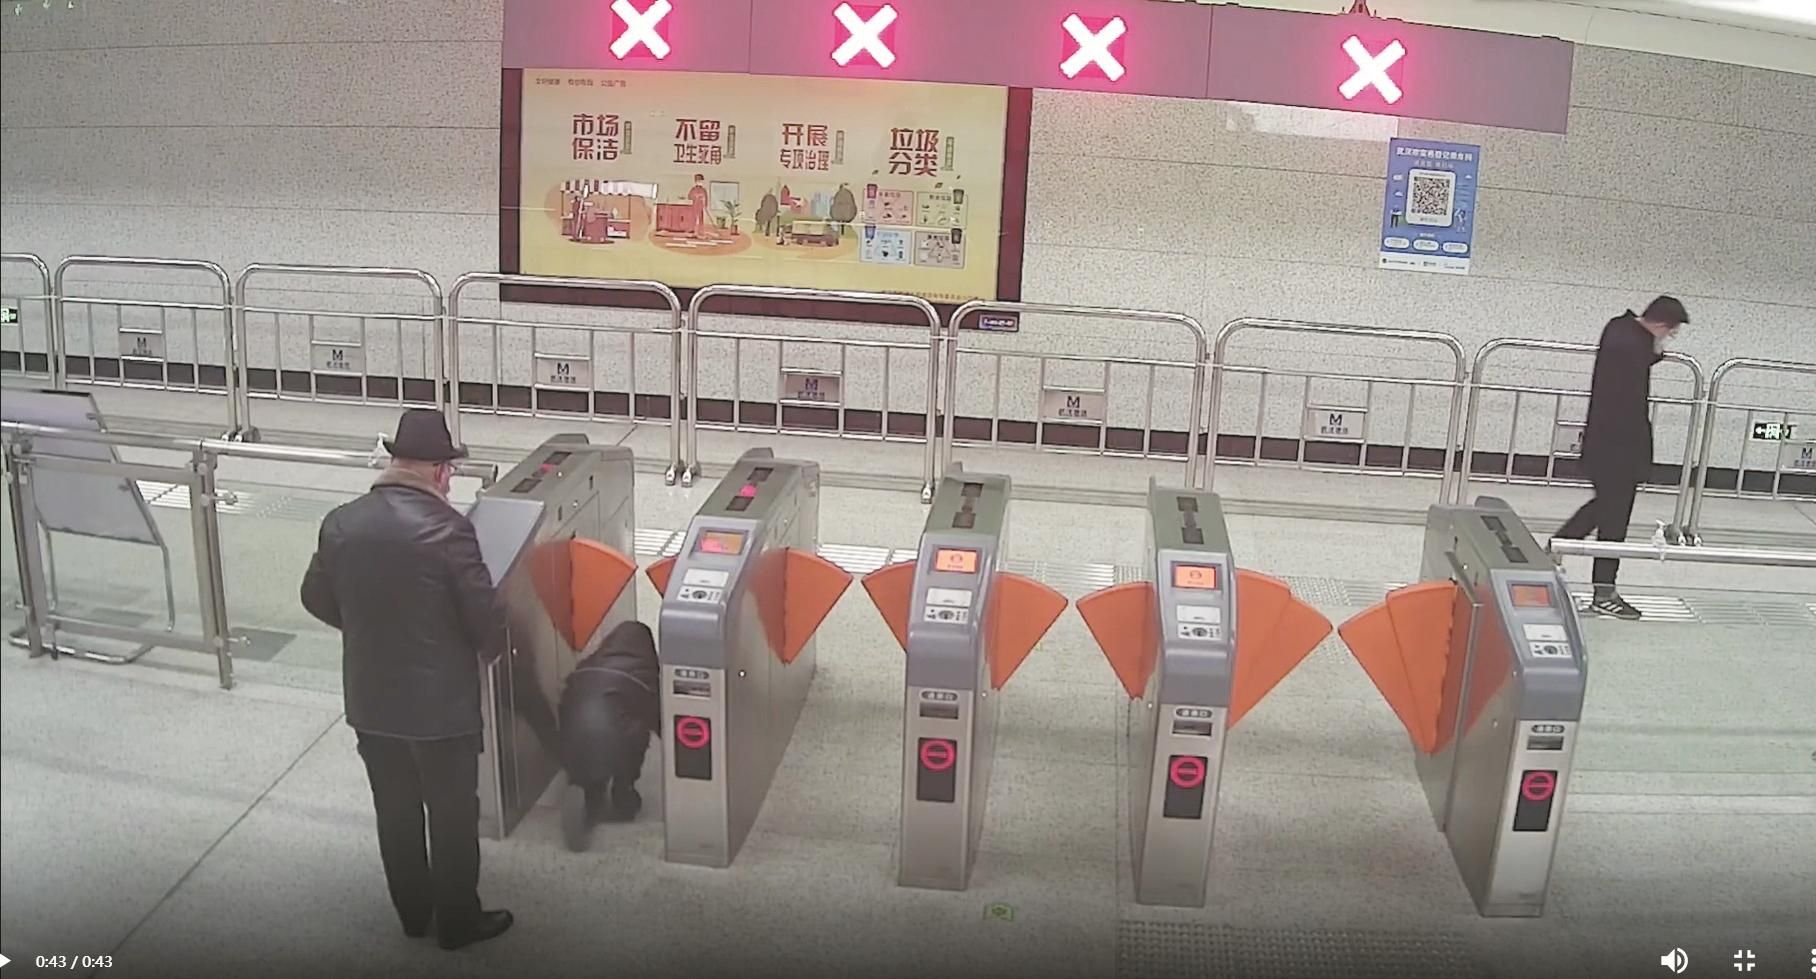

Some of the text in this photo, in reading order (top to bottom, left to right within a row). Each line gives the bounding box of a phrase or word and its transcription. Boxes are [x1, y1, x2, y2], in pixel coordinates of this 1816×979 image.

[572, 113, 620, 136] 市场
[674, 118, 721, 142] 不留
[781, 123, 829, 147] 开展
[571, 138, 620, 161] 保洁
[889, 127, 940, 153] 垃圾
[672, 143, 722, 166] 卫生死角
[779, 148, 830, 172] 专项治理
[888, 151, 939, 177] 分类
